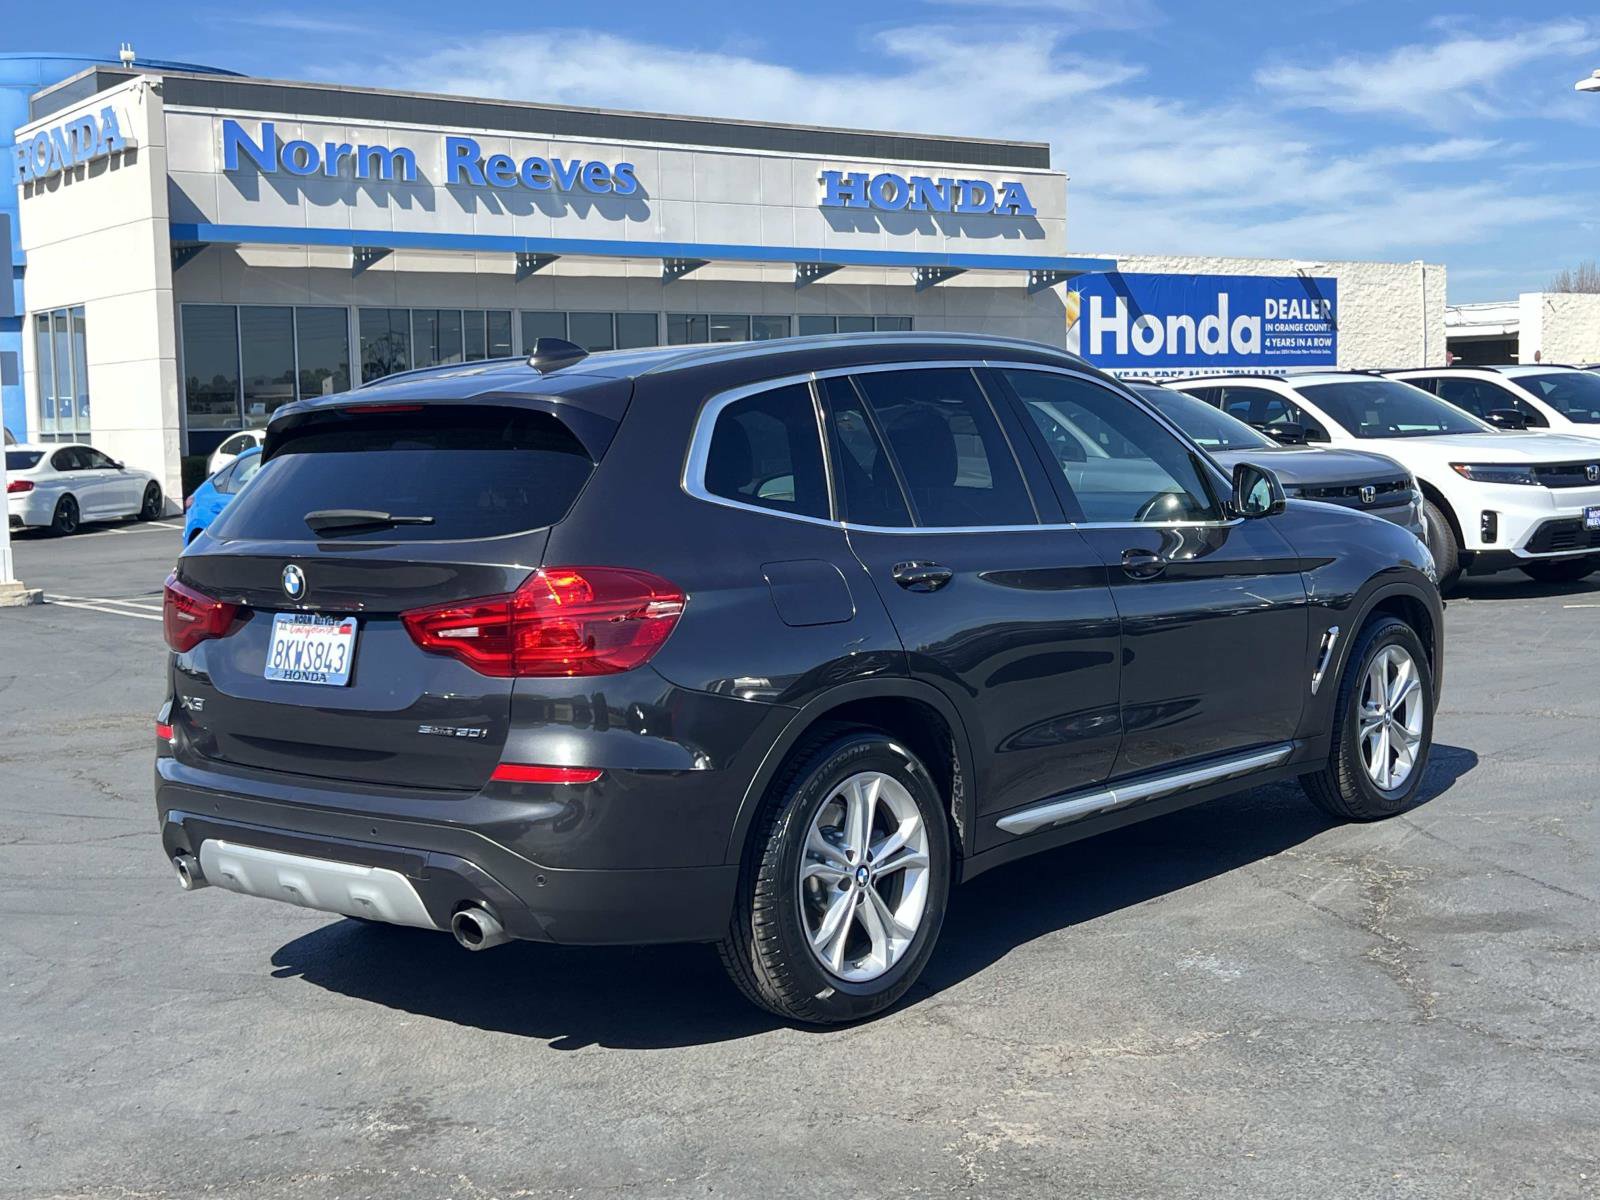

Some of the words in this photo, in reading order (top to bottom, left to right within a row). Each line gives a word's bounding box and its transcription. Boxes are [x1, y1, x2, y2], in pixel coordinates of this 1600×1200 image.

[11, 105, 127, 185] HONDA
[222, 119, 417, 182] Norm
[445, 136, 638, 195] Reeves
[821, 170, 1038, 216] HONDA
[1089, 292, 1261, 356] Honda
[1265, 298, 1332, 320] DEALER
[1265, 323, 1273, 332] IN
[1274, 323, 1303, 332] ORANGE
[1265, 338, 1271, 347] 4
[1272, 338, 1296, 347] YEARS
[1296, 338, 1306, 347] IN
[1306, 338, 1313, 347] A
[1313, 338, 1332, 347] ROW
[273, 640, 346, 673] 8KWS843
[283, 669, 327, 682] HONDA
